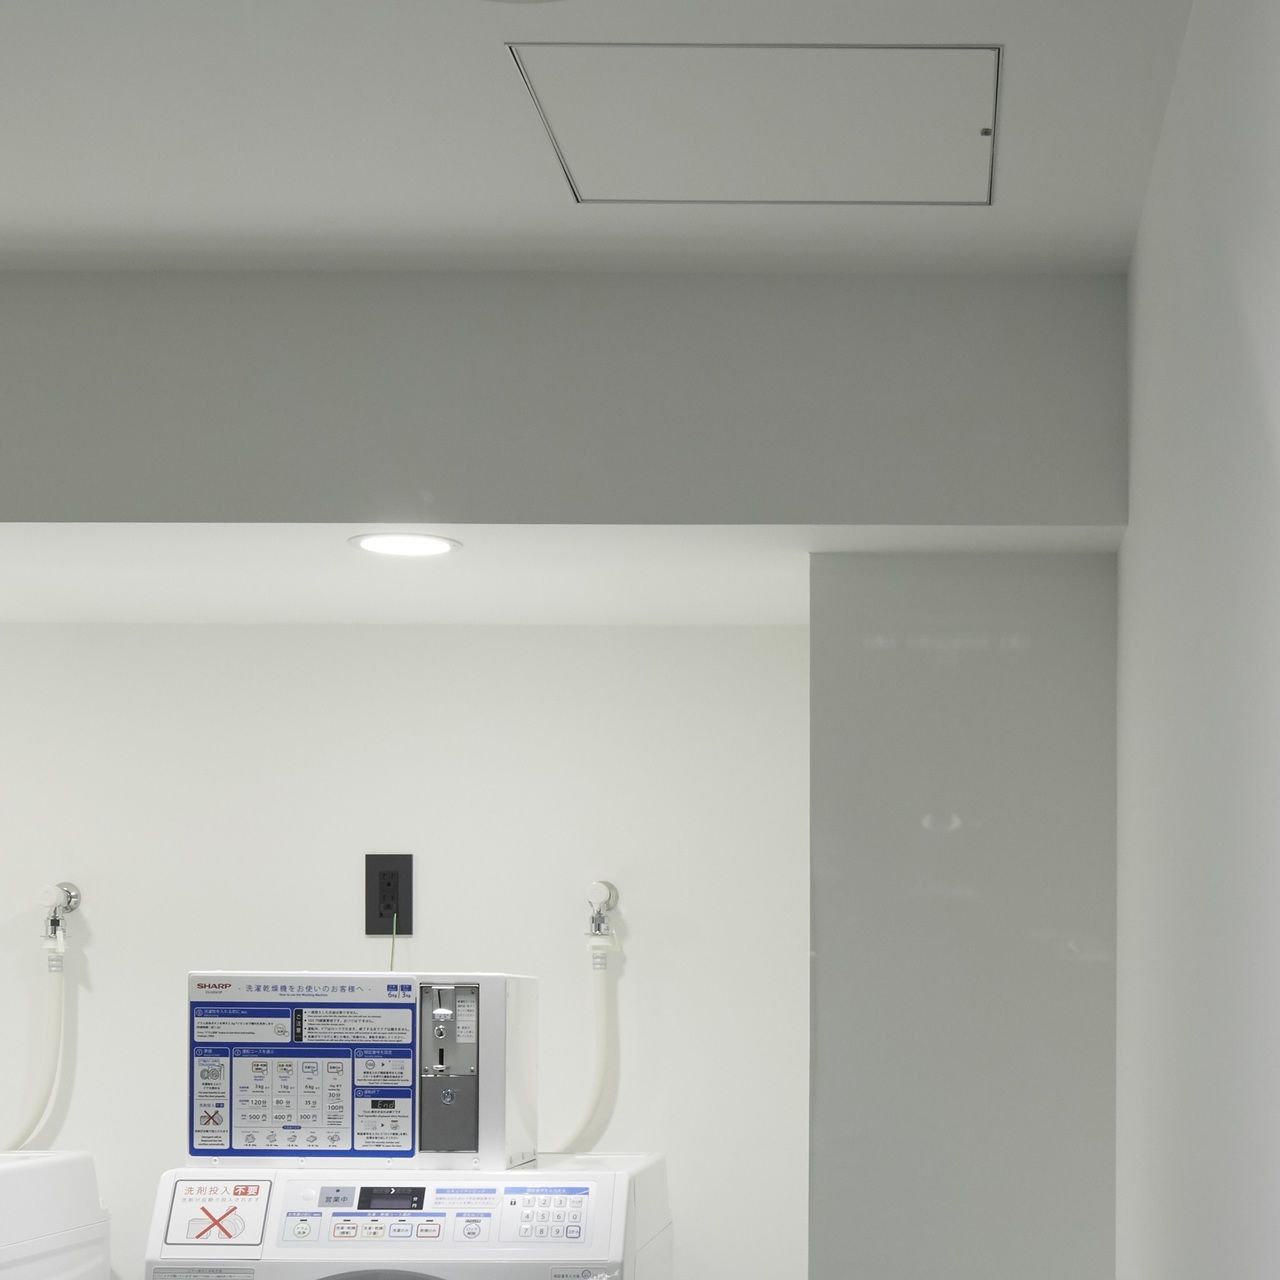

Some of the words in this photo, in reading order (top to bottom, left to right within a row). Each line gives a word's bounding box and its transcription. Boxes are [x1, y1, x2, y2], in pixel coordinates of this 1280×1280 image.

[245, 984, 364, 994] 洗濯乾燥機をお使いのお客様へ
[183, 1186, 231, 1196] 洗剤投入
[234, 1186, 259, 1196] 不要
[324, 1195, 348, 1203] 営業中
